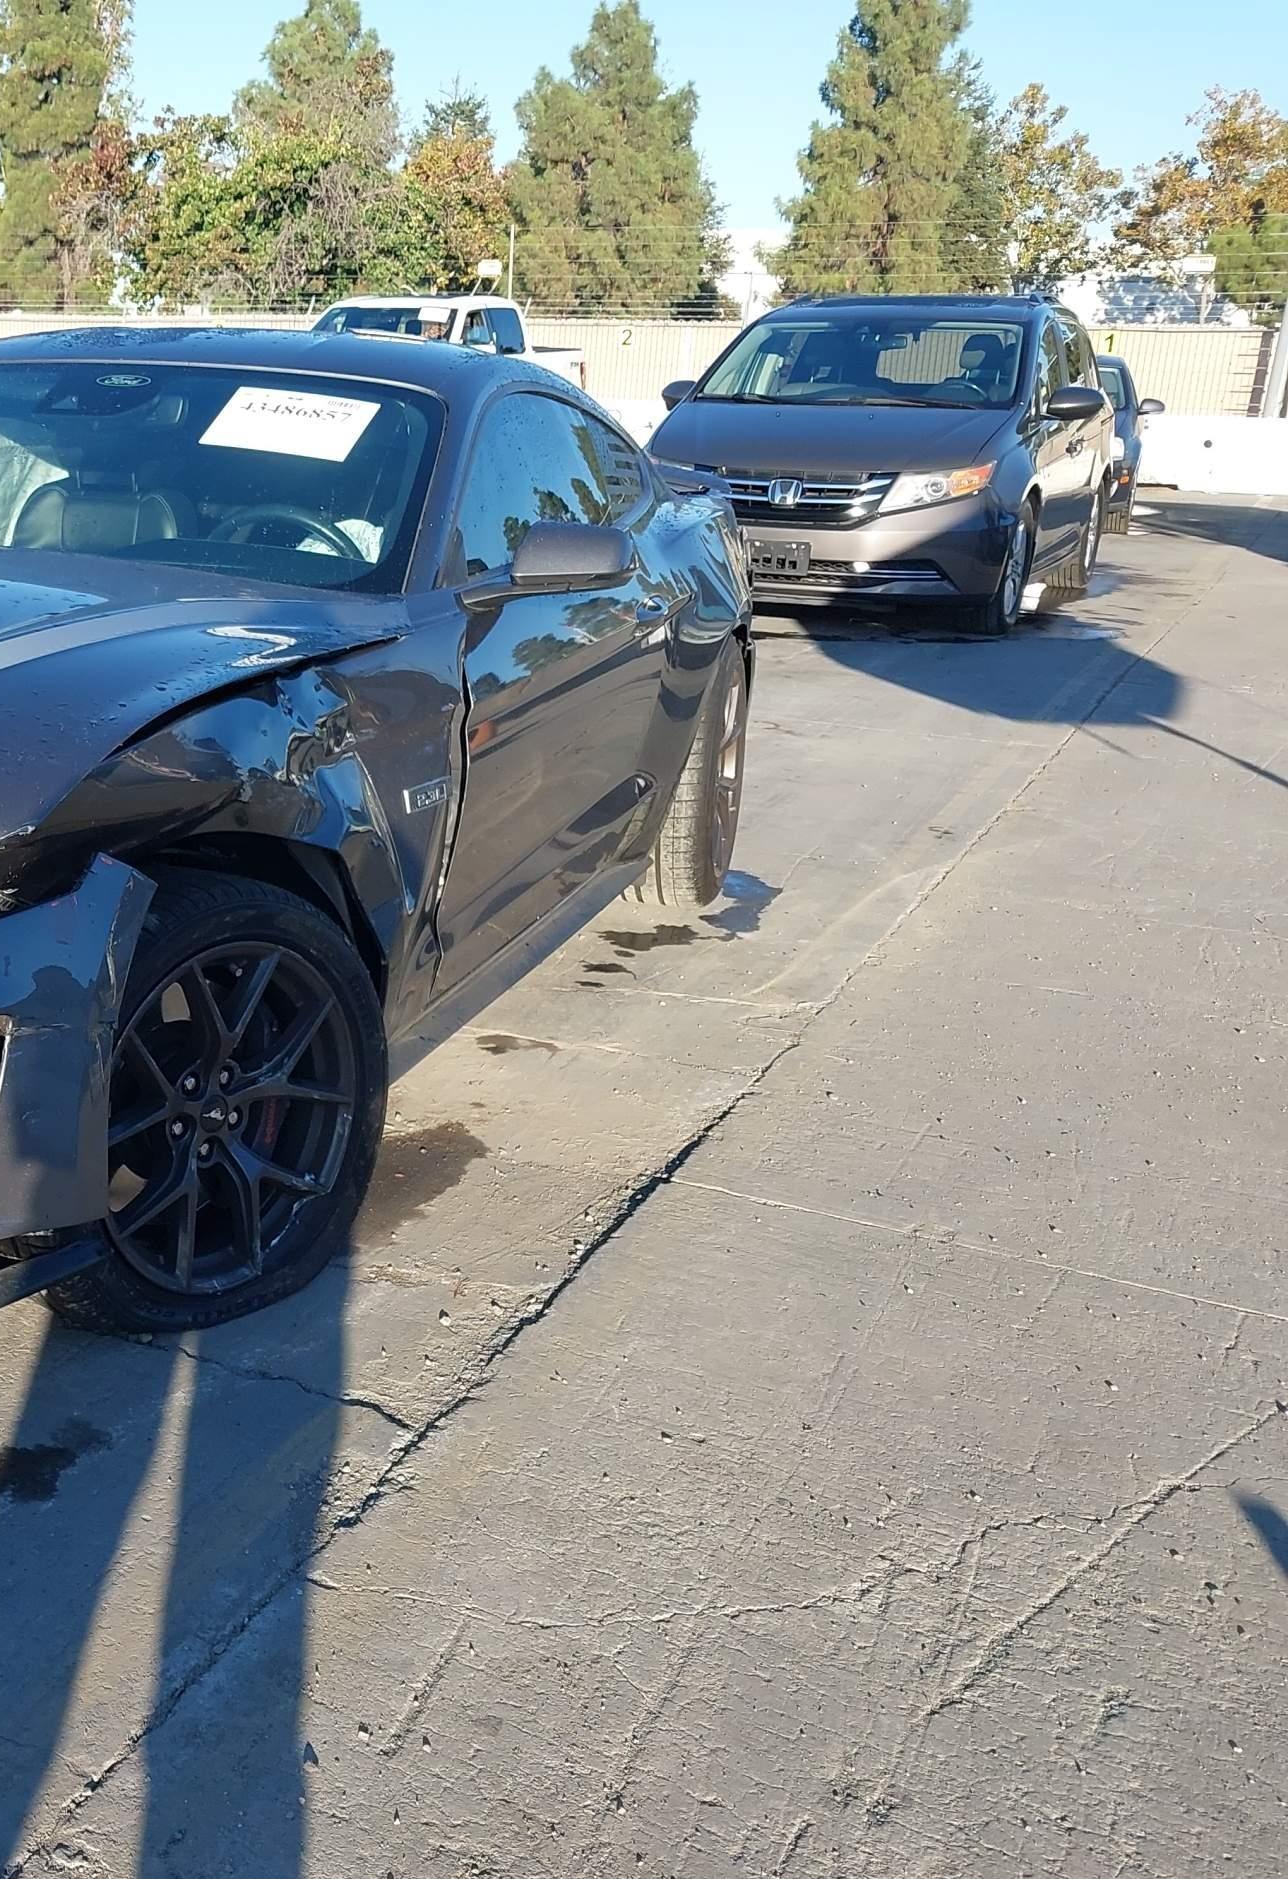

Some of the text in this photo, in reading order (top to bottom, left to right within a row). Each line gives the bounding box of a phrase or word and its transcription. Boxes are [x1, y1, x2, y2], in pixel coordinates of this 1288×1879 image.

[621, 329, 633, 346] 2
[1104, 333, 1114, 353] 1
[101, 375, 145, 386] Ford
[240, 401, 353, 423] 43486857
